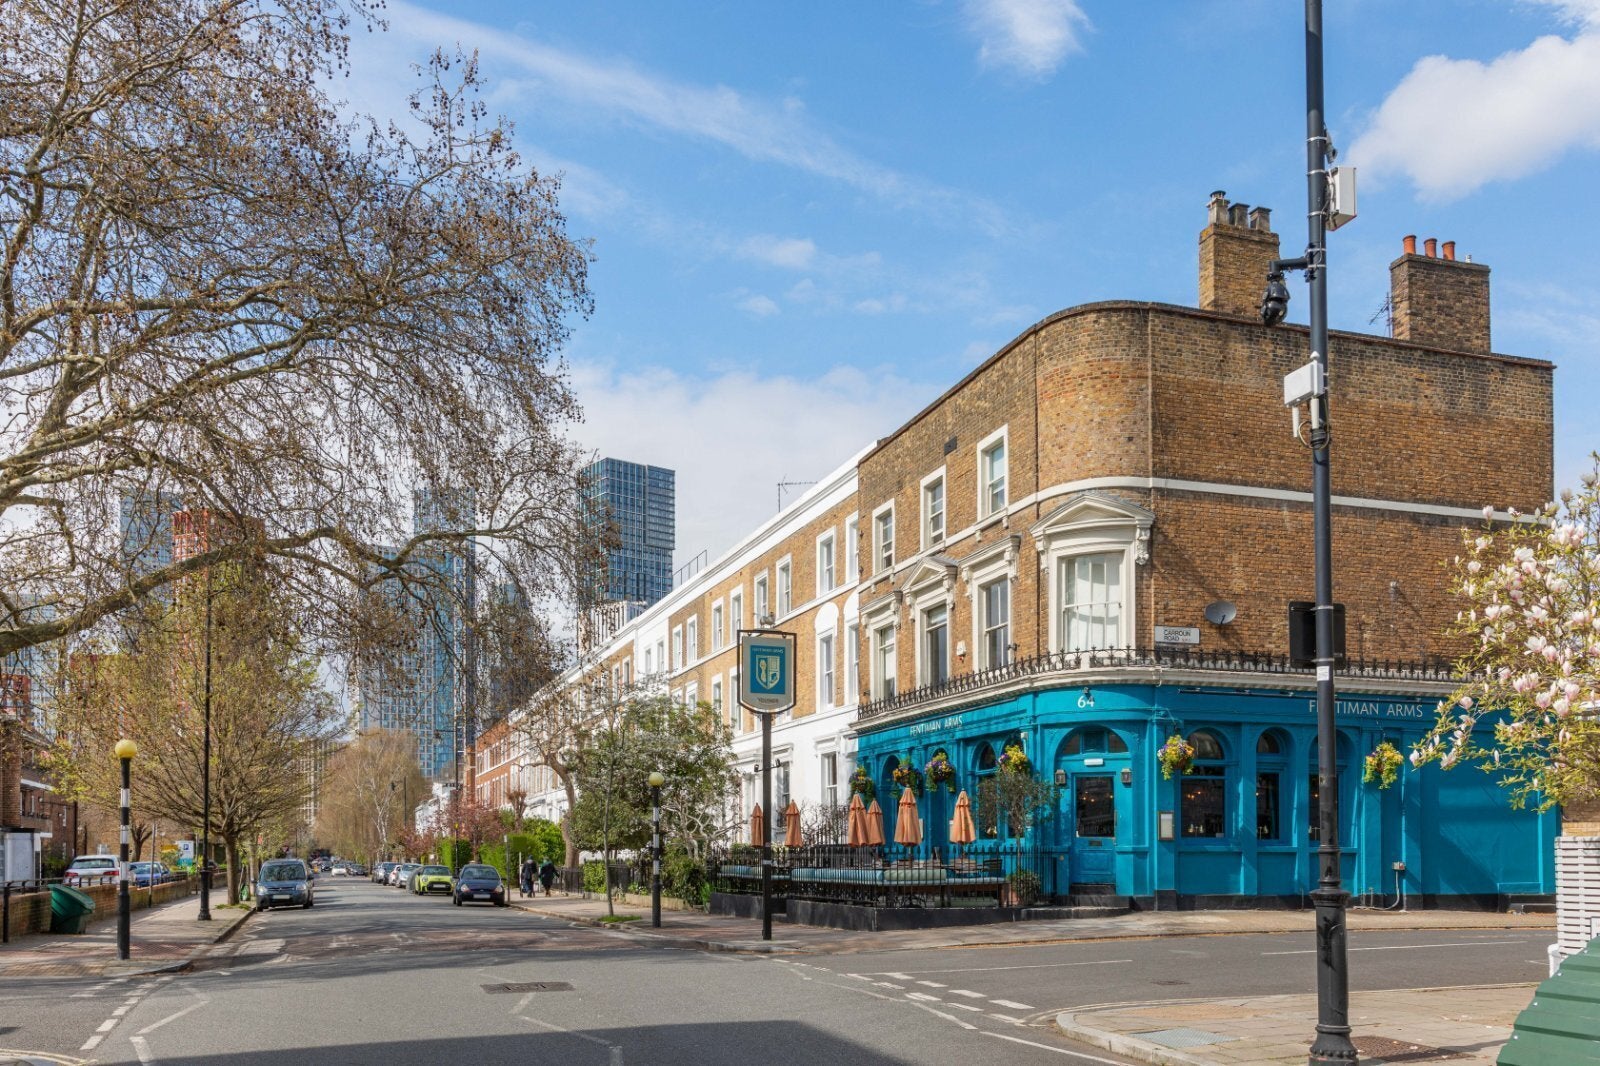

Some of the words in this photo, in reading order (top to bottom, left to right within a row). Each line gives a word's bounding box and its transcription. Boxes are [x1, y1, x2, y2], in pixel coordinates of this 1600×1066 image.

[1077, 695, 1095, 708] 64
[1309, 700, 1378, 715] FTIMAN
[1387, 703, 1423, 718] ARMS
[910, 720, 940, 736] FENTIMAN
[944, 715, 963, 729] ARMS
